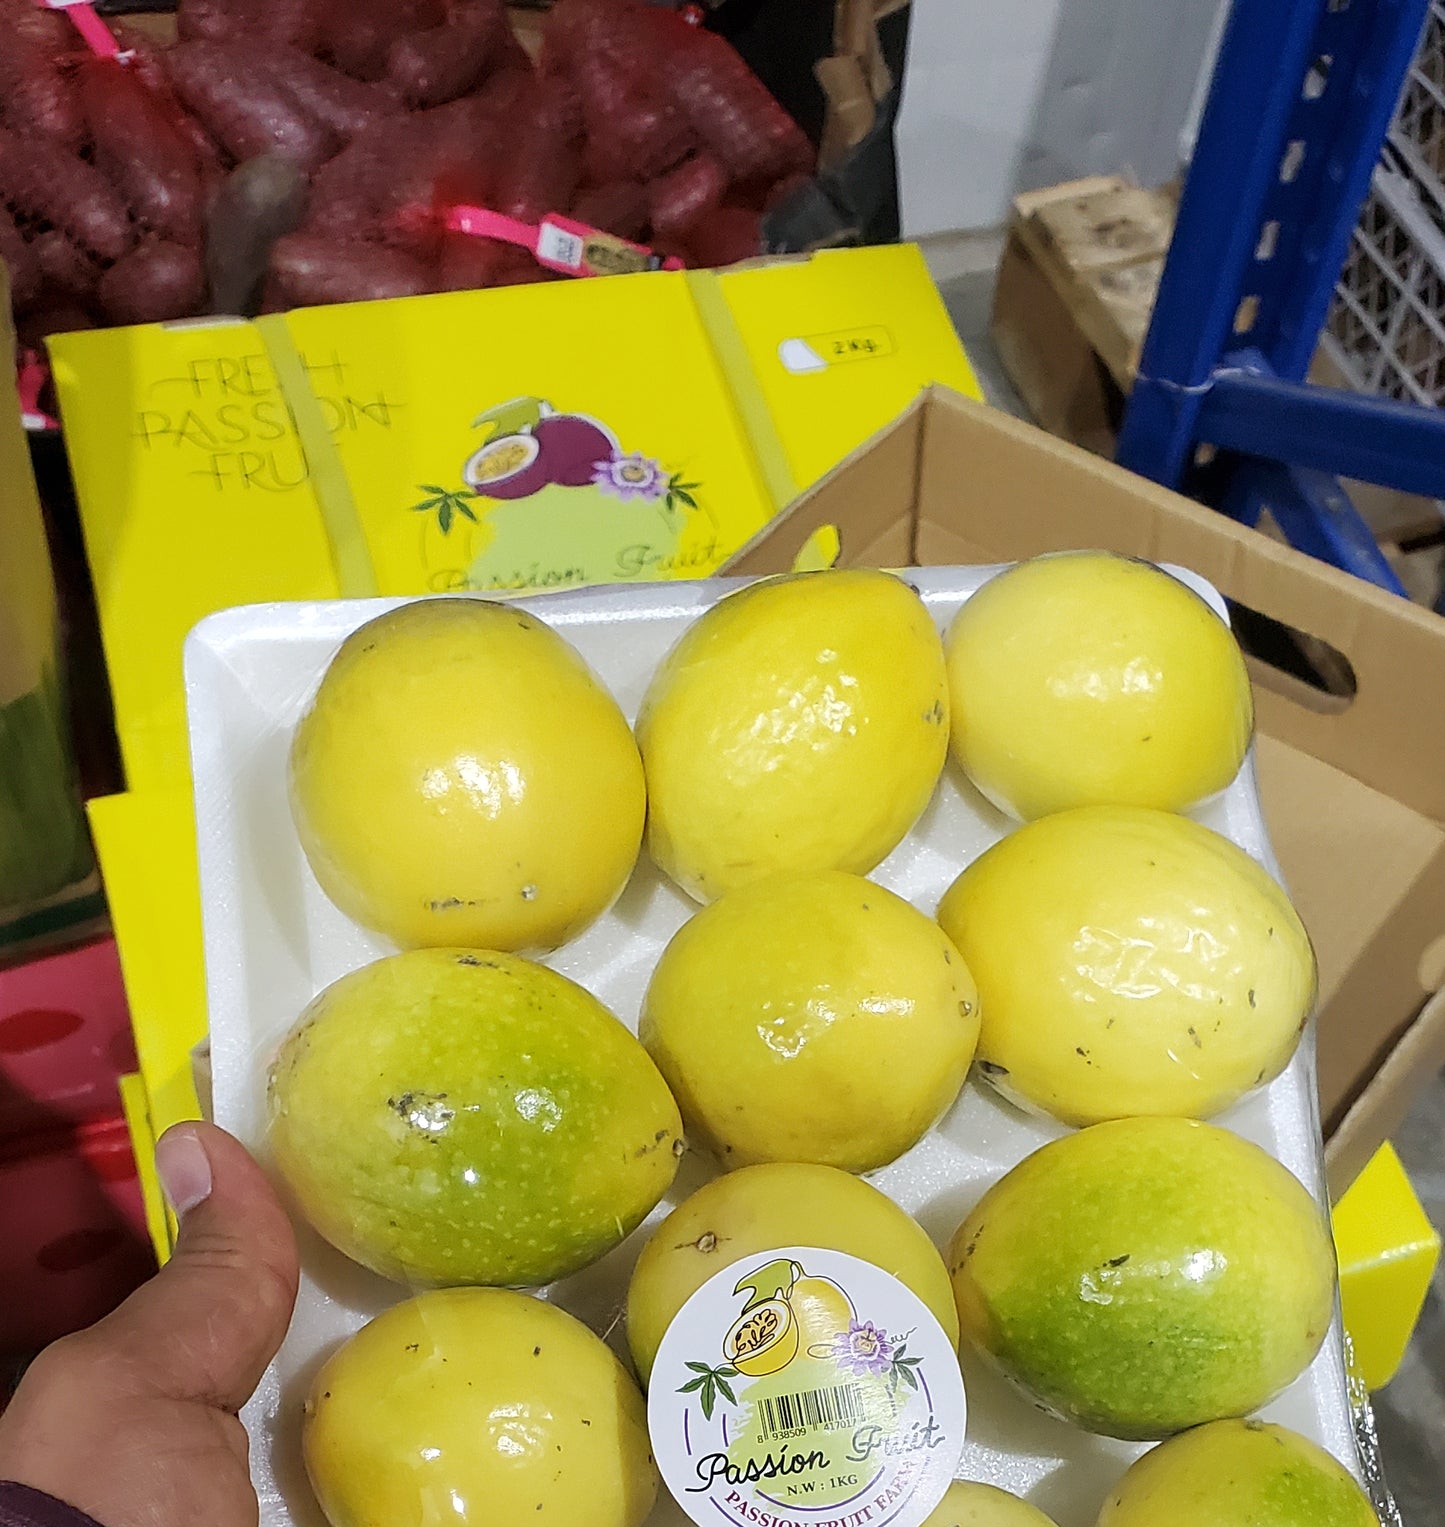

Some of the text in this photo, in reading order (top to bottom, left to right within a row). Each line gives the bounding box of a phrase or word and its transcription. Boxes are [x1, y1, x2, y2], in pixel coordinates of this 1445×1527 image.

[150, 350, 350, 399] FREH
[187, 441, 341, 493] FRU
[612, 535, 734, 578] Fruit
[684, 1415, 946, 1493] Passion Fruit
[757, 1433, 764, 1444] 8
[772, 1427, 807, 1442] 938509
[830, 1474, 858, 1490] 1KG
